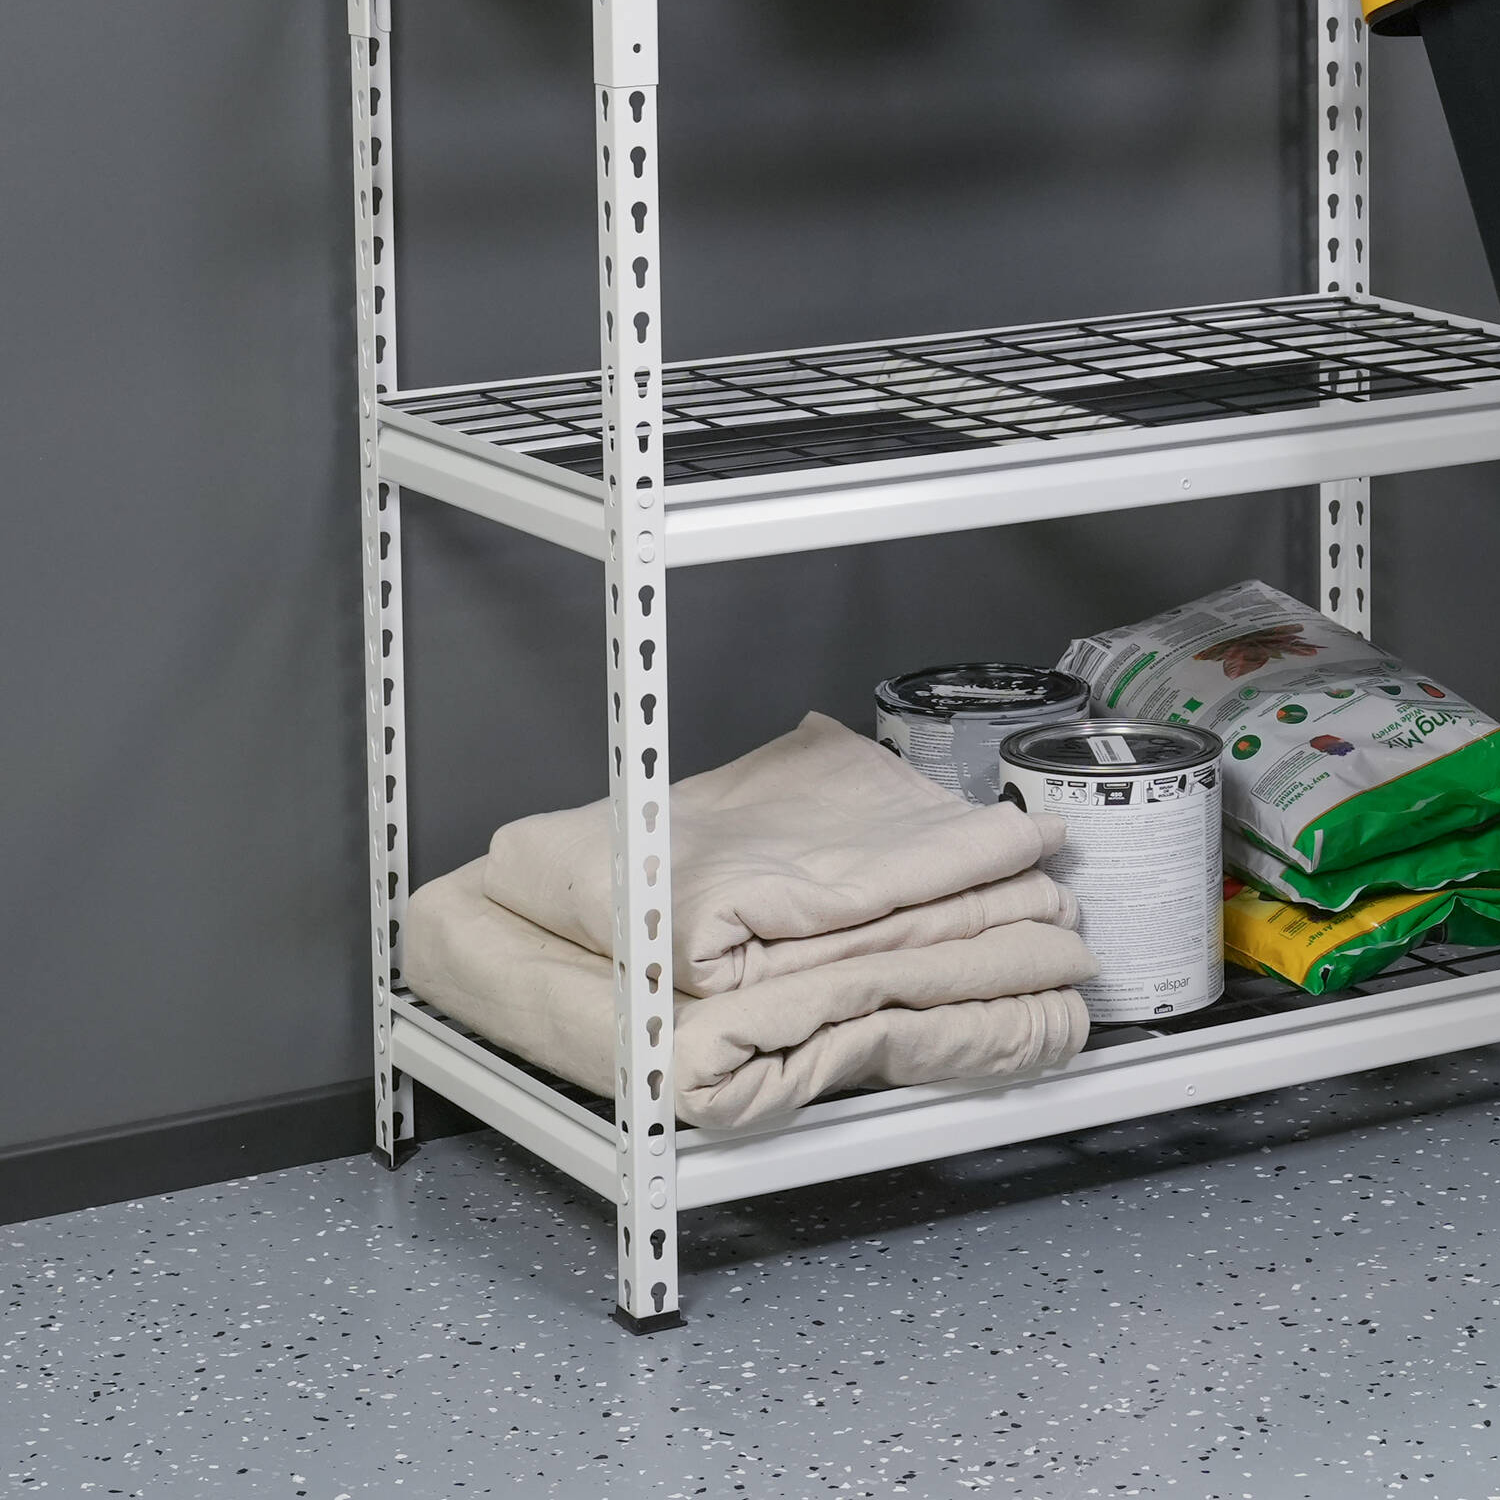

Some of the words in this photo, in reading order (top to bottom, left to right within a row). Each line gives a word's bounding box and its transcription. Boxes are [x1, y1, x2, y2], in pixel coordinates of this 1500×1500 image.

[1402, 708, 1425, 723] Wide
[1371, 721, 1402, 740] Variety
[1153, 976, 1191, 992] valspar
